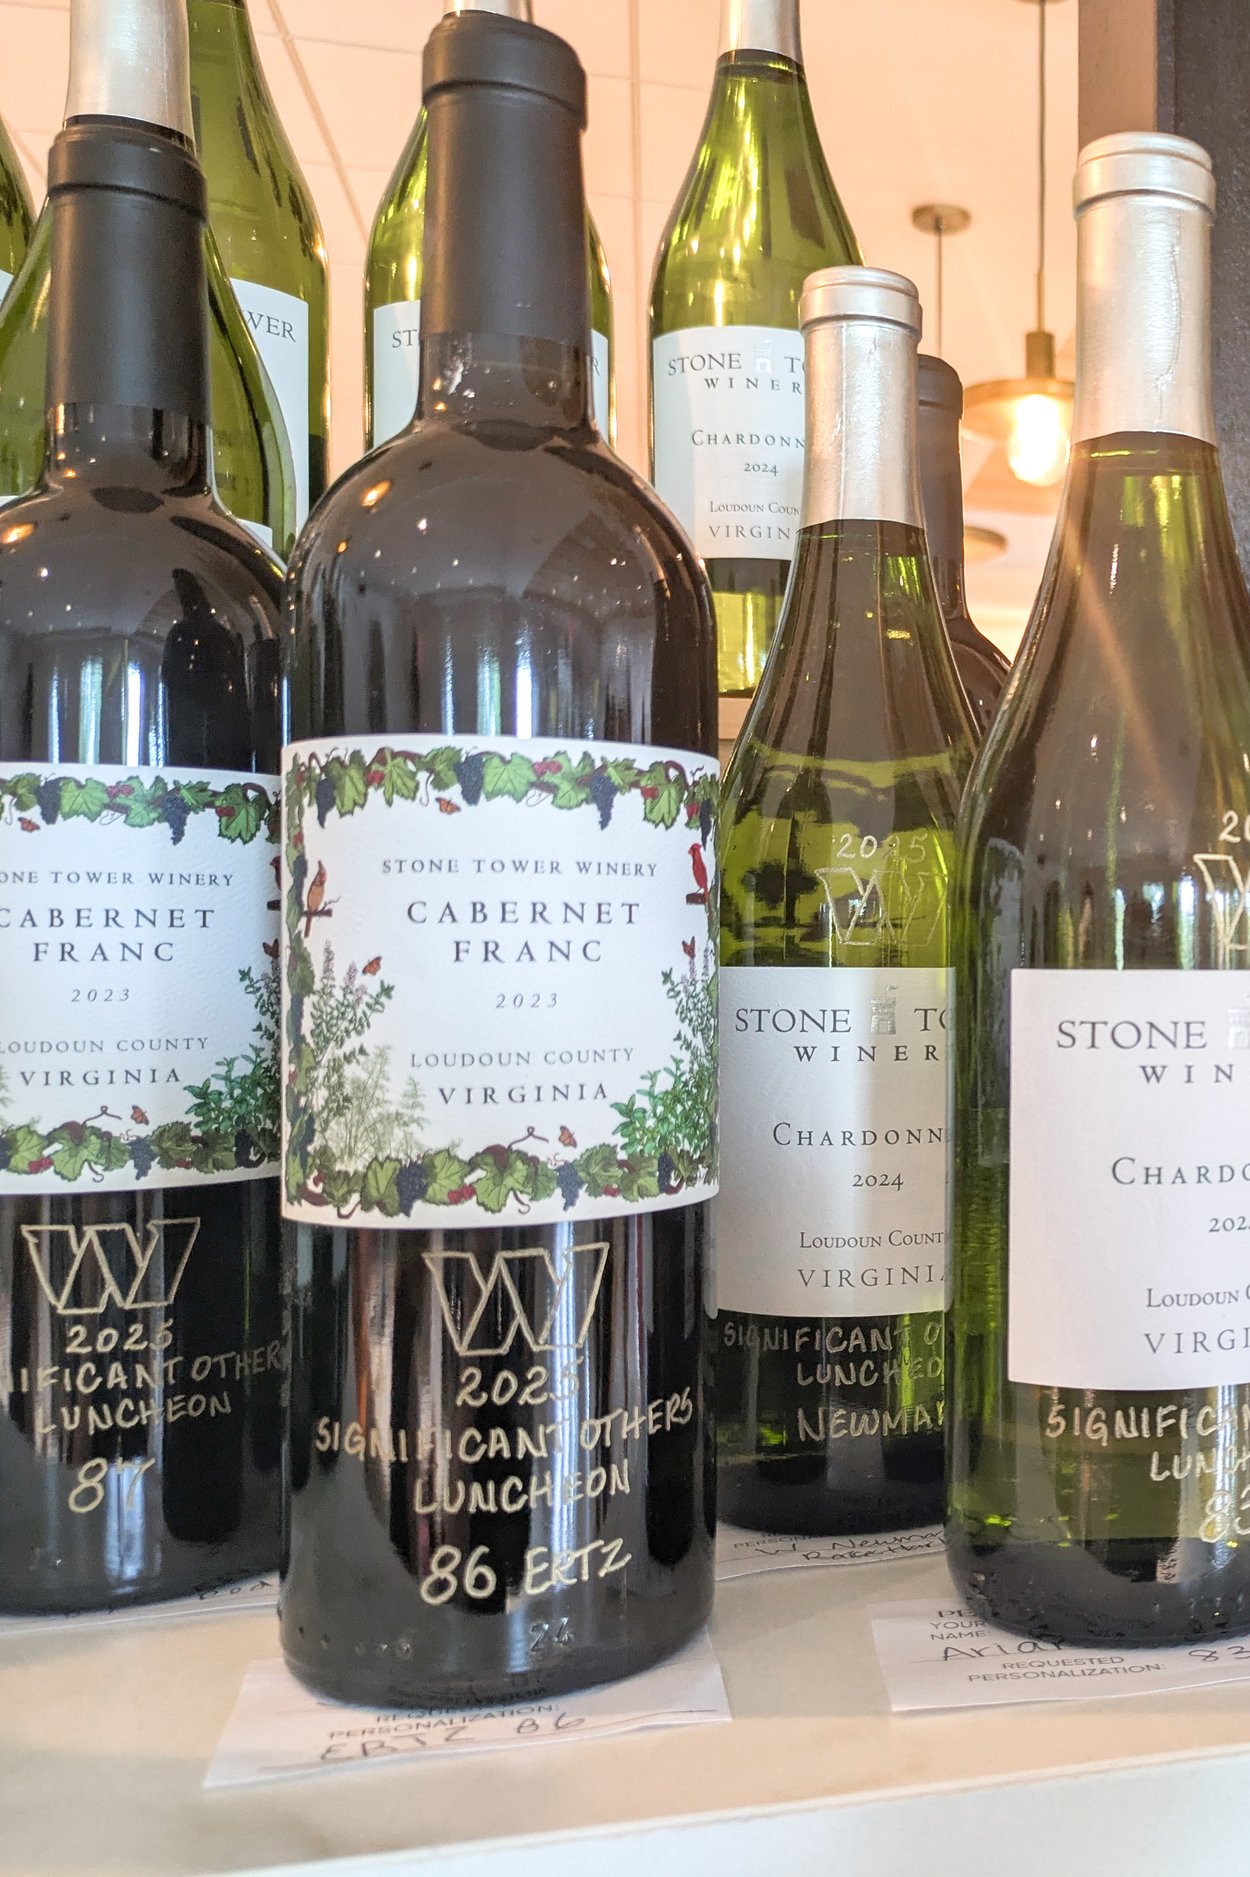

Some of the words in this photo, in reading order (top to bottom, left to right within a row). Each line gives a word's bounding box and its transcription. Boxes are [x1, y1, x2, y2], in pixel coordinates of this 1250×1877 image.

[243, 309, 296, 343] WER
[668, 352, 742, 376] STONE
[704, 376, 804, 395] WINER
[691, 430, 805, 449] CHARDONN
[743, 462, 779, 476] 2024
[709, 501, 764, 513] LOUDOUN
[768, 502, 801, 516] COUN
[709, 525, 791, 540] VIRGIN
[382, 858, 460, 875] STONE
[473, 859, 562, 875] TOWER
[576, 860, 658, 877] WINERY
[0, 871, 39, 885] ONE
[51, 871, 135, 886] TOWER
[149, 871, 234, 887] WINERY
[0, 907, 215, 929] CABERNET
[407, 900, 641, 925] CABERNET
[33, 941, 175, 963] FRANC
[453, 939, 603, 964] FRANC
[71, 987, 130, 1002] 2023
[496, 993, 559, 1009] 2023
[734, 1008, 852, 1034] STONE
[117, 1037, 209, 1052] COUNTY
[1056, 1020, 1207, 1050] STONE
[411, 1050, 531, 1068] LOUDOUN
[544, 1047, 635, 1065] COUNTY
[793, 1044, 943, 1063] WINER
[20, 1067, 181, 1087] VIRGINIA
[438, 1082, 608, 1105] VIRGINIA
[772, 1121, 944, 1147] CHARDONN
[852, 1171, 904, 1192] 2024
[799, 1231, 882, 1249] LOUDOUN
[888, 1228, 944, 1248] COUNT
[1146, 1288, 1239, 1309] LOUDOUN
[66, 1319, 175, 1354] 2025
[20, 1355, 184, 1395] IFICANT
[456, 1356, 584, 1408] 2025
[796, 1357, 944, 1386] LUNCHEO
[34, 1391, 232, 1435] LUNCHEON
[315, 1415, 570, 1464] SIGNIFICANT
[579, 1385, 694, 1451] OTHERS
[68, 1456, 155, 1513] 87
[413, 1457, 630, 1515] LUNCHEON
[420, 1544, 497, 1606] 86
[523, 1537, 632, 1596] ERTZ
[968, 1662, 1167, 1683] PERSONALIZATION:
[1000, 1655, 1125, 1671] REQUESTED
